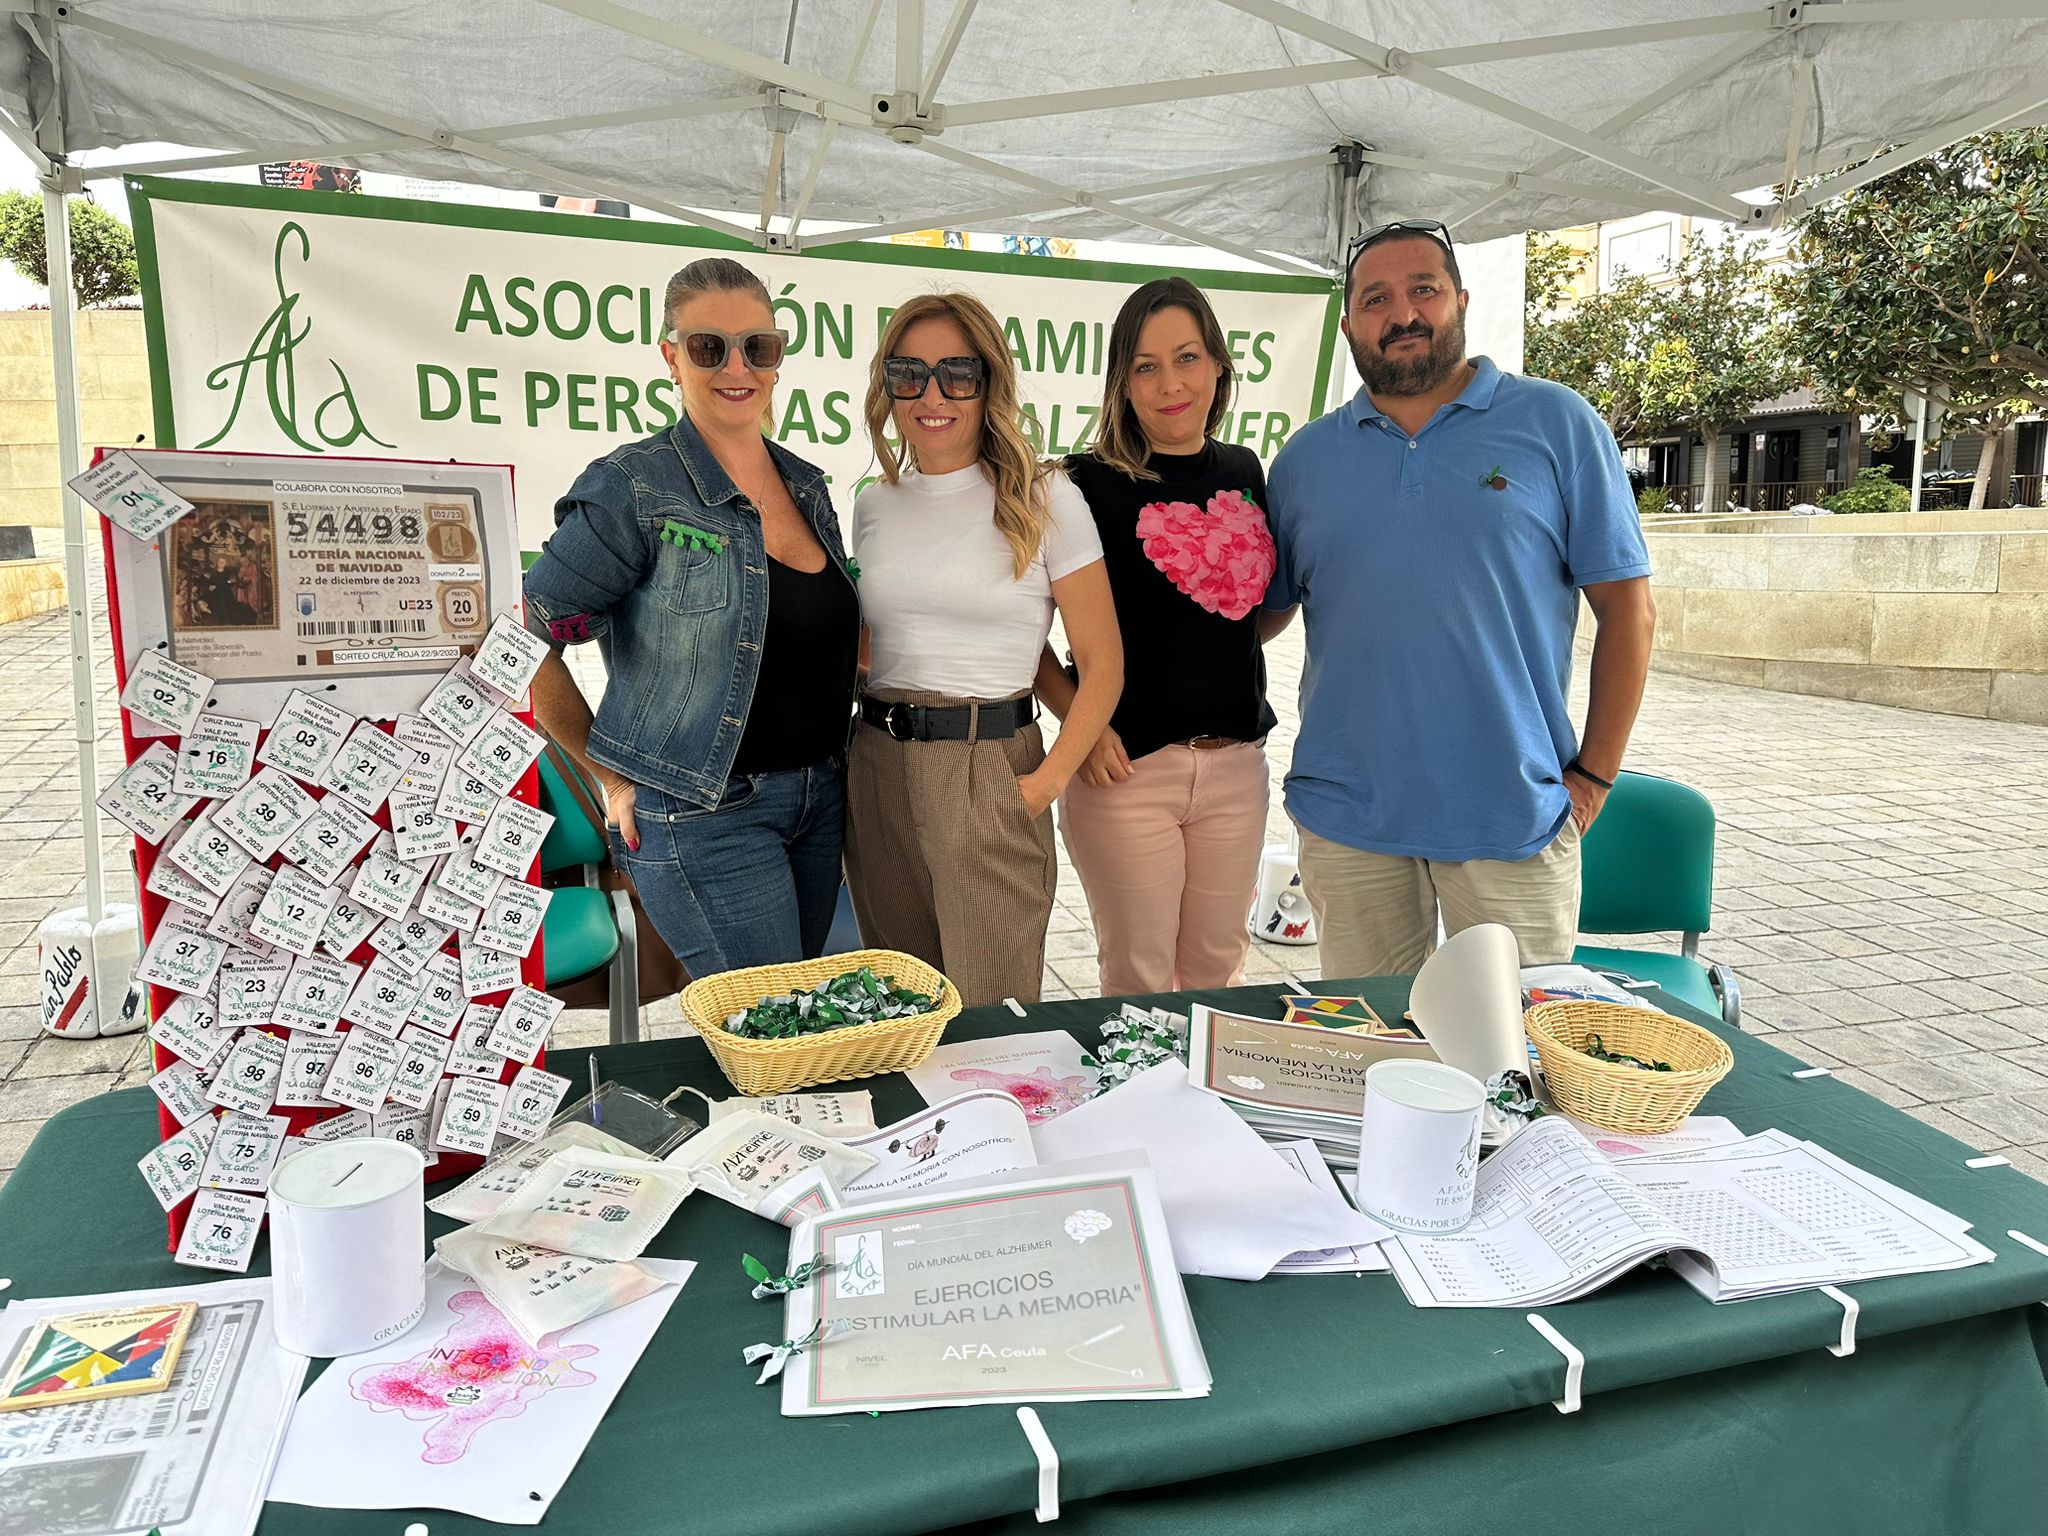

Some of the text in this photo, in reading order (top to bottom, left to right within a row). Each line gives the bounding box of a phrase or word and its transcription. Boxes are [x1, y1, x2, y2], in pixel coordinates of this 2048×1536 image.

[417, 364, 498, 424] DE
[527, 372, 851, 446] PERSAS
[275, 483, 402, 496] COLABORA CON NOSOTROS
[121, 489, 144, 508] 01
[287, 512, 421, 539] 54498
[289, 548, 425, 560] LOTERÍA NACIONAL
[316, 564, 403, 573] DE NAVIDAD
[458, 568, 465, 577] 2
[299, 576, 421, 586] 22 de diciembre de 2023
[453, 600, 472, 614] 20
[335, 649, 459, 661] SORTEO CRUZ ROJA 22/9/2023
[500, 651, 519, 668] 43
[153, 688, 177, 707] 02
[455, 691, 474, 710] 49
[296, 729, 317, 748] 03
[207, 749, 227, 765] 16
[492, 744, 511, 762] 50
[356, 758, 377, 777] 21
[142, 783, 167, 804] 24
[464, 778, 483, 795] 55
[255, 802, 277, 822] 39
[414, 813, 434, 827] 95
[317, 829, 339, 849] 22
[502, 830, 522, 847] 28
[208, 836, 230, 859] 32
[383, 868, 402, 886] 14
[286, 903, 306, 922] 12
[336, 904, 356, 923] 04
[503, 909, 522, 926] 58
[406, 921, 427, 939] 88
[175, 940, 200, 958] 37
[481, 950, 500, 966] 74
[244, 978, 266, 994] 23
[305, 985, 326, 1002] 31
[432, 986, 452, 1002] 90
[377, 986, 398, 1004] 38
[192, 1010, 214, 1030] 13
[515, 1017, 534, 1033] 66
[1326, 1048, 1364, 1061] AFA
[243, 1064, 266, 1082] 98
[305, 1061, 326, 1076] 97
[354, 1061, 375, 1079] 96
[405, 1059, 425, 1076] 99
[194, 1069, 214, 1089] 44
[1279, 1067, 1366, 1086] ERCICIOS
[521, 1096, 540, 1113] 67
[462, 1107, 481, 1123] 59
[395, 1127, 415, 1142] 68
[234, 1143, 256, 1159] 75
[177, 1151, 197, 1173] 06
[886, 1178, 899, 1187] LA
[900, 1161, 940, 1183] MEMORIA
[941, 1152, 961, 1165] CON
[924, 1171, 948, 1187] Ceuta
[213, 1192, 251, 1205] CRUZ ROJA
[213, 1203, 246, 1213] VALE POR
[226, 1213, 256, 1223] NAVIDAD
[1381, 1207, 1429, 1229] GRACIAS
[1430, 1218, 1450, 1229] POR
[211, 1223, 233, 1240] 76
[907, 1240, 1053, 1271] DÍA MUNDIAL DEL ALZHEIMER
[914, 1271, 1054, 1306] EJERCICIOS
[983, 1302, 1013, 1321] LA
[373, 1308, 420, 1342] GRACIAS
[942, 1343, 1047, 1361] AFA Ceuta
[981, 1366, 1007, 1374] 2023
